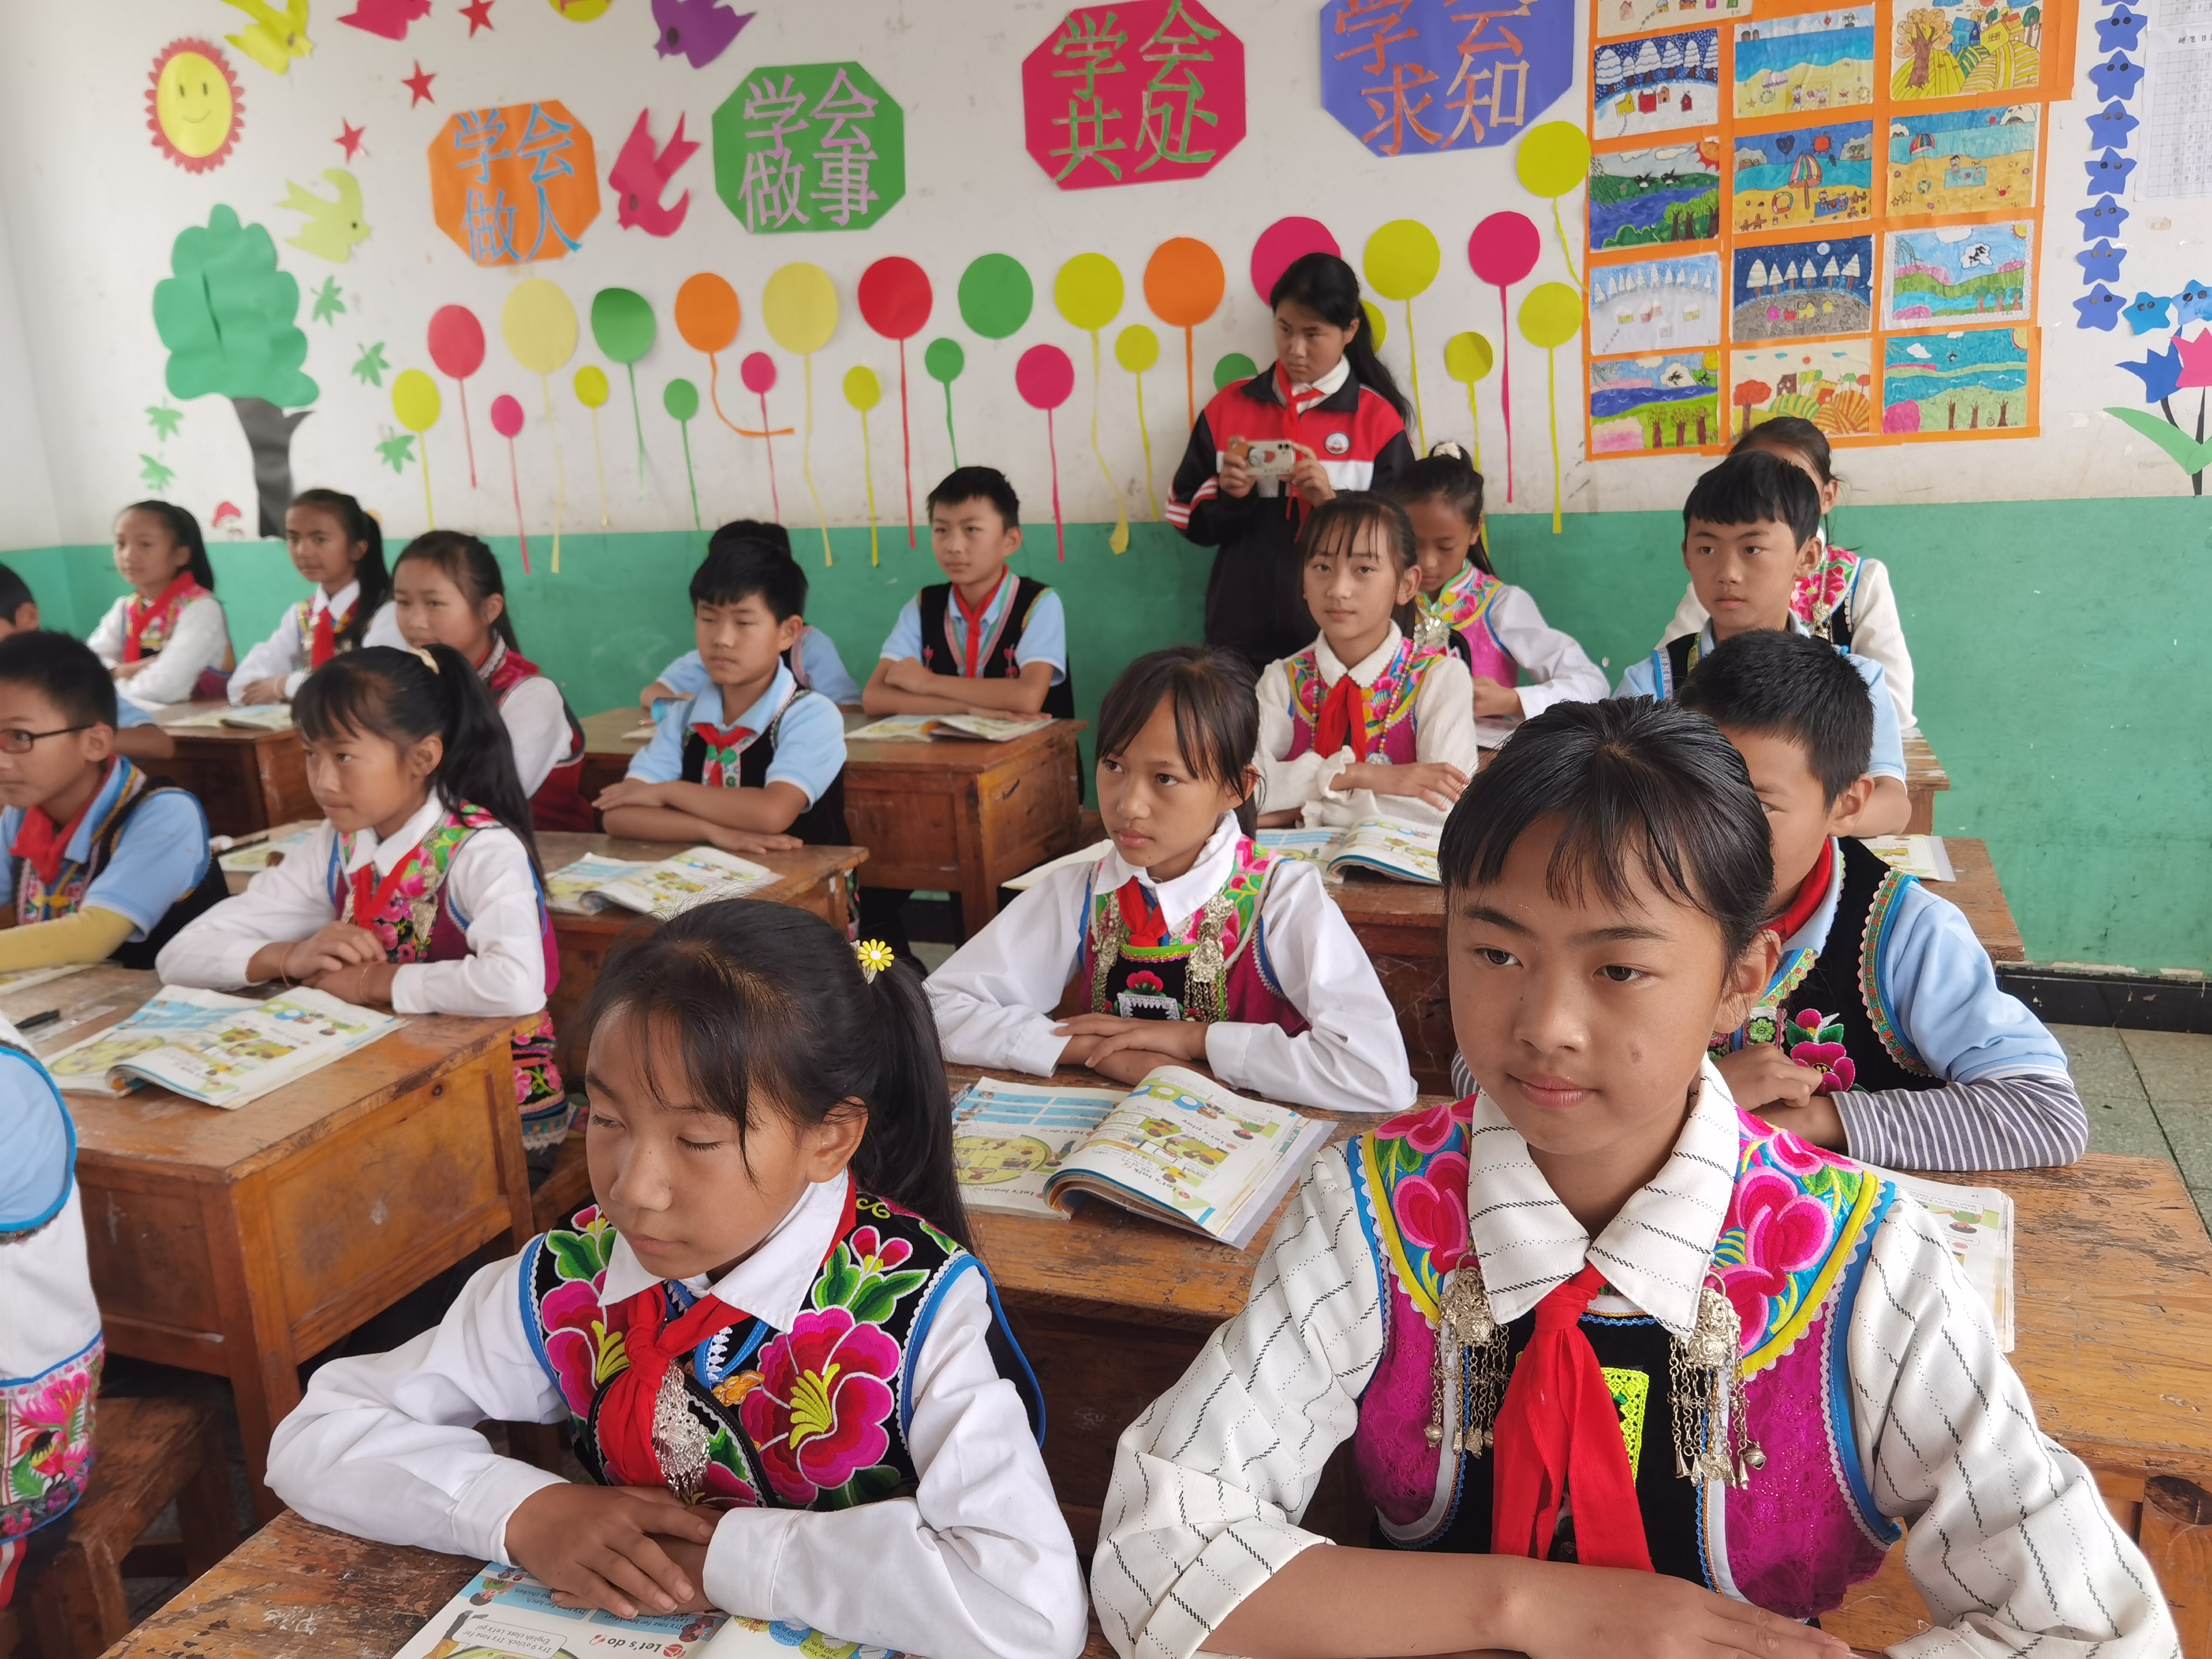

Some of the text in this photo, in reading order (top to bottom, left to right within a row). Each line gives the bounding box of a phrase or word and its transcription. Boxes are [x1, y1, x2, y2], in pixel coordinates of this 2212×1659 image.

[1053, 0, 1220, 101] 学会
[1361, 53, 1529, 156] 求知
[743, 68, 878, 158] 学会
[1049, 90, 1218, 181] 共处
[453, 104, 575, 184] 学会
[738, 146, 878, 233] 做事
[462, 184, 582, 262] 做人
[1182, 1120, 1202, 1131] play
[1133, 1168, 1152, 1178] talk
[515, 1589, 541, 1597] chicken
[475, 1632, 491, 1641] time
[488, 1626, 505, 1635] Let's
[525, 1634, 550, 1645] English
[771, 1631, 797, 1645] London
[537, 1644, 552, 1654] It's
[608, 1638, 663, 1653] Let's do
[802, 1644, 818, 1656] York
[811, 1640, 840, 1657] 7:10 a.m.
